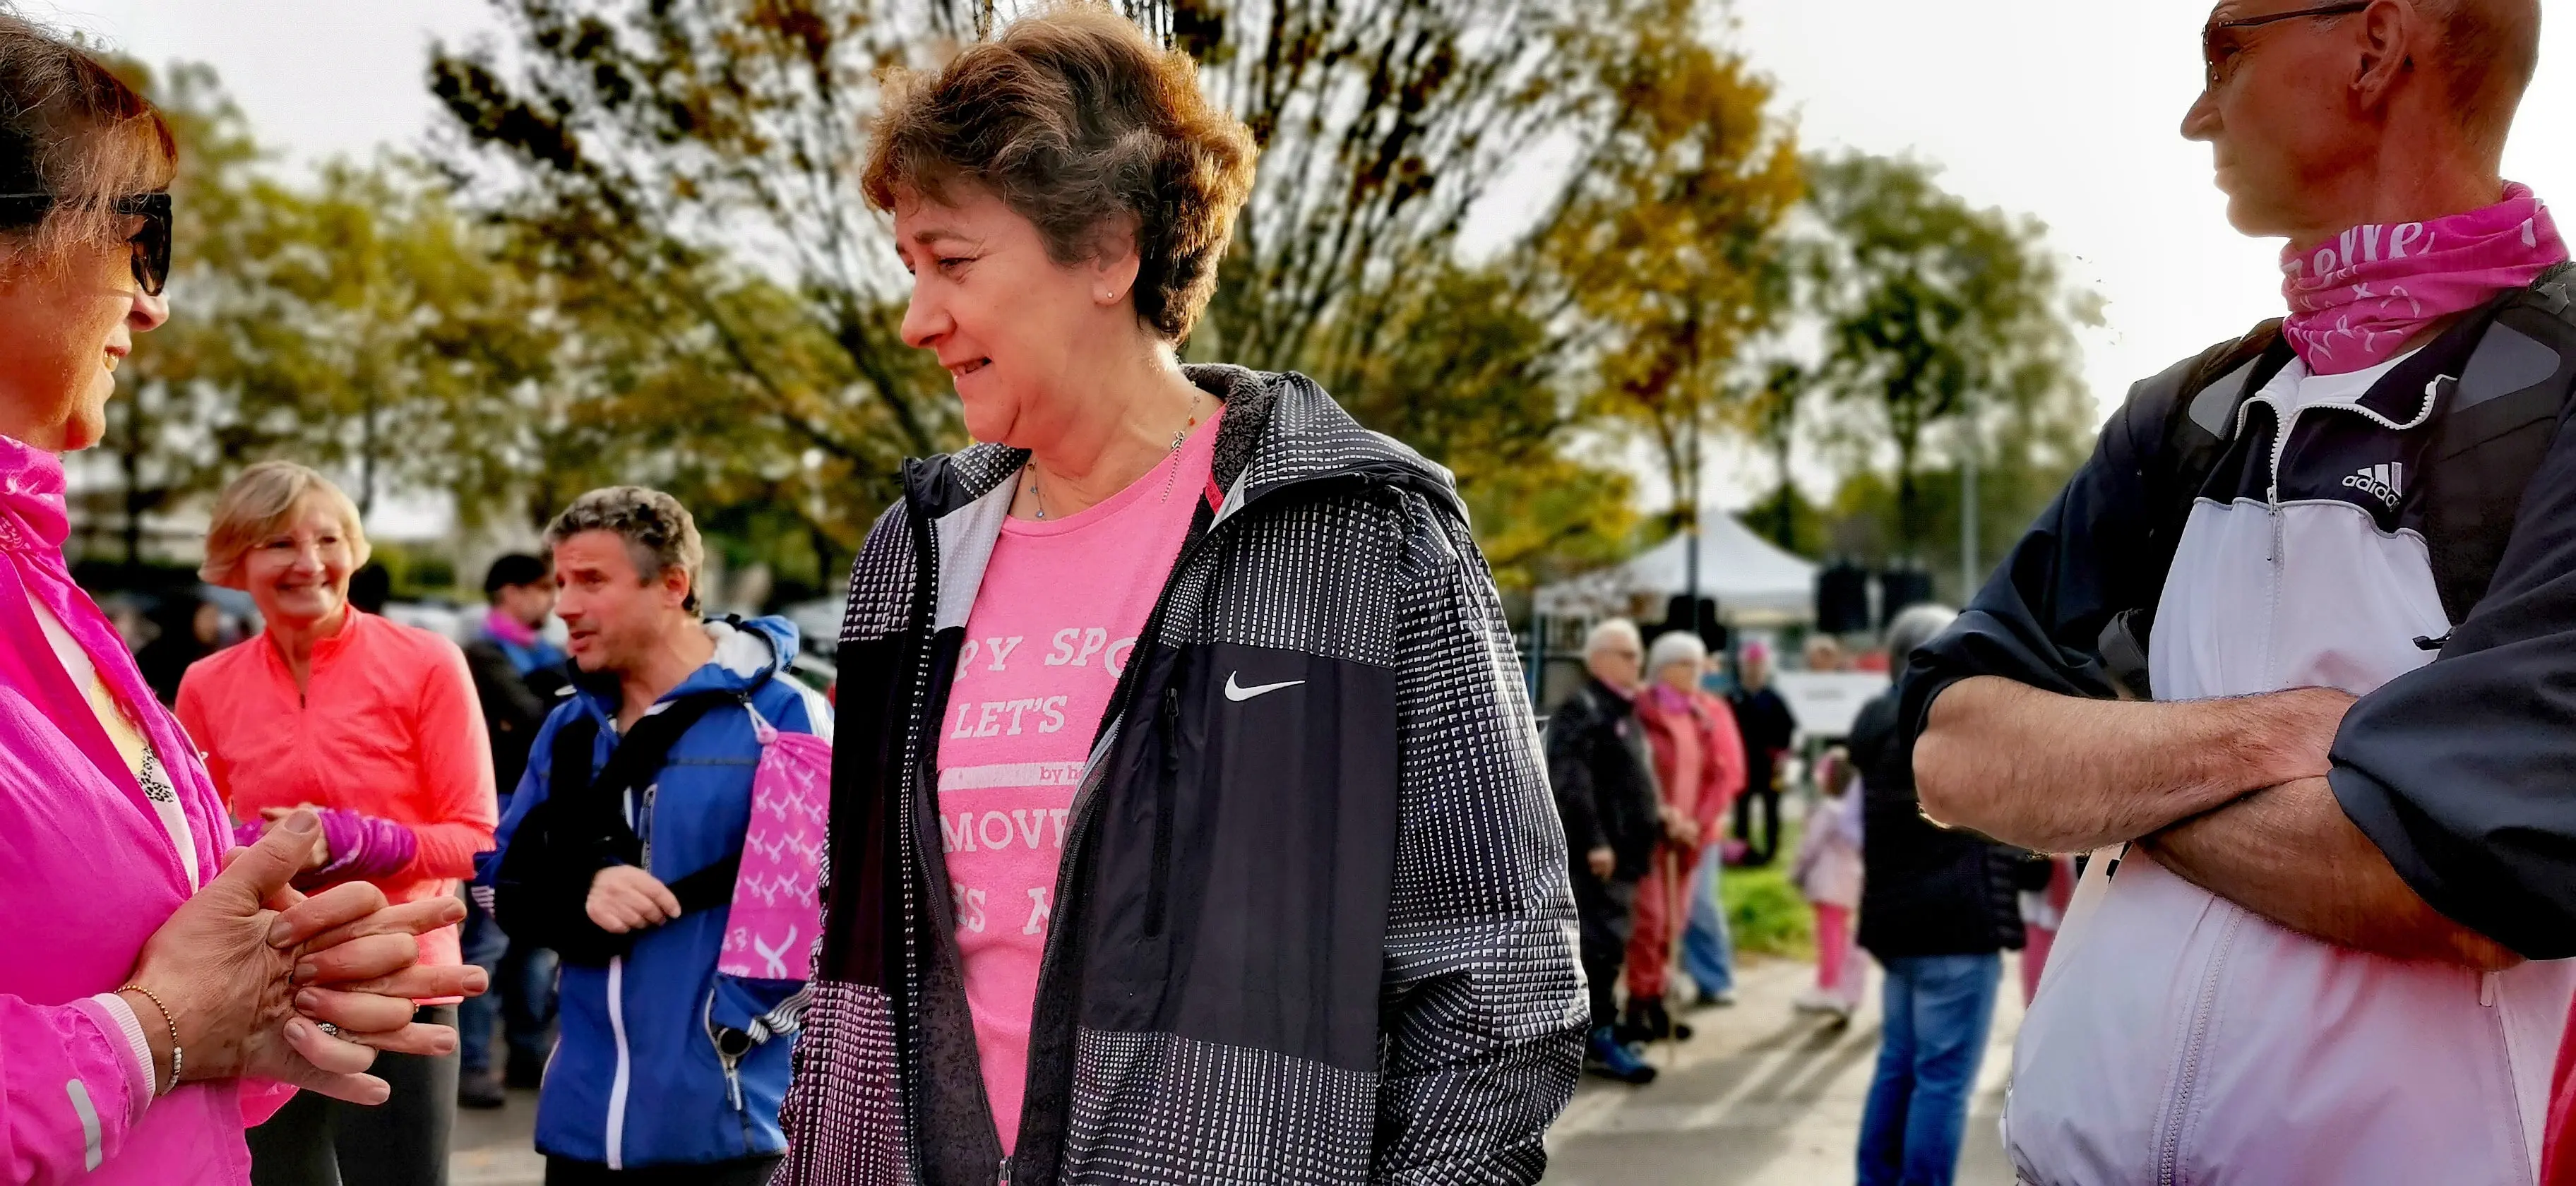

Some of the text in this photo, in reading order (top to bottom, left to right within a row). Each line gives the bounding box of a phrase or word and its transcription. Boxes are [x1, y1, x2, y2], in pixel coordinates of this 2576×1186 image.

[2342, 474, 2400, 512] adidas
[950, 695, 1068, 739] LET'S
[1039, 766, 1063, 784] by
